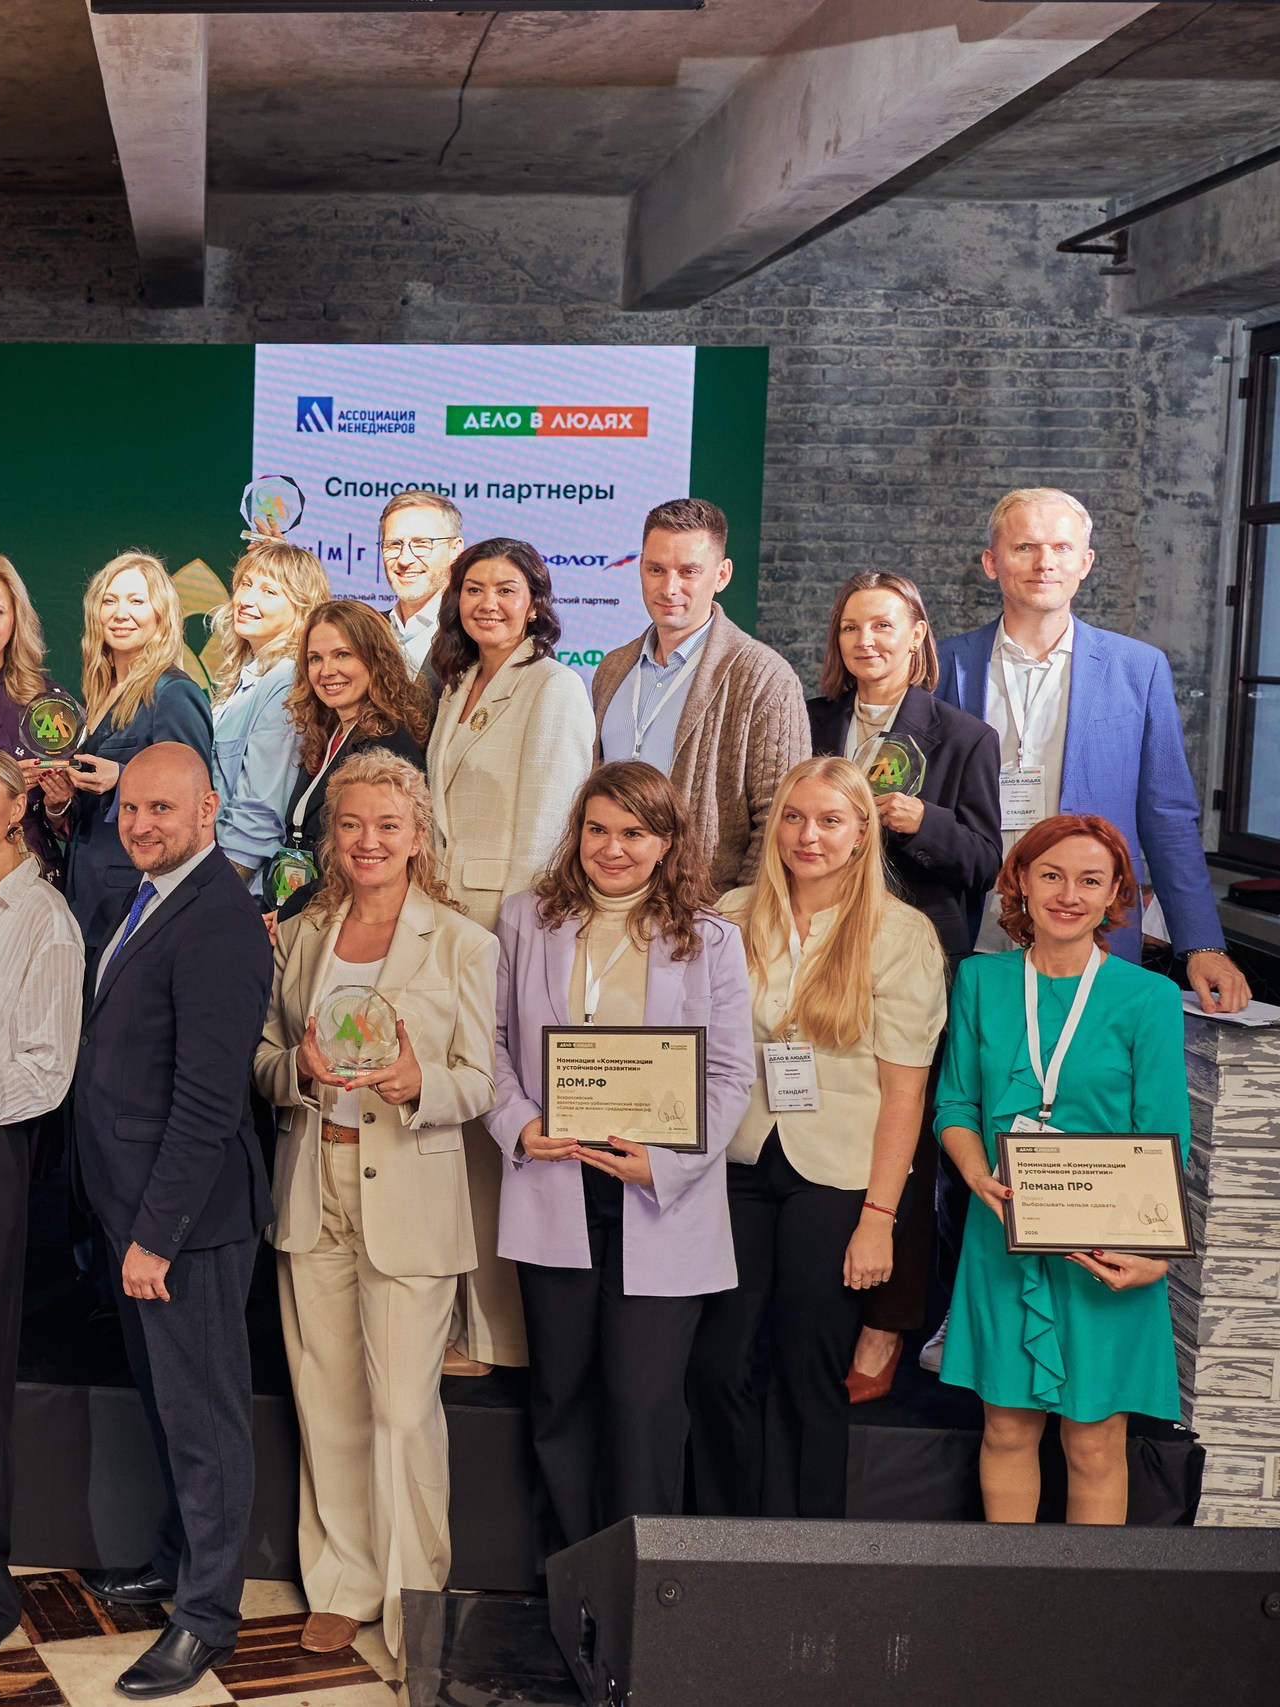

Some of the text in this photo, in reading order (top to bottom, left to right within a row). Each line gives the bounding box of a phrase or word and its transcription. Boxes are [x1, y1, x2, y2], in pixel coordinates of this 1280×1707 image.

[338, 410, 416, 422] АССОЦИАЦИЯ
[464, 412, 633, 430] ДЕЛО В ЛЮДЯХ
[338, 423, 416, 435] МЕНЕДЖЕРОВ
[464, 482, 479, 498] и
[487, 482, 615, 504] партнеры
[582, 598, 620, 606] партнер
[557, 1078, 607, 1088] ДОМ.РФ
[1020, 1182, 1093, 1191] Лемана ПРО
